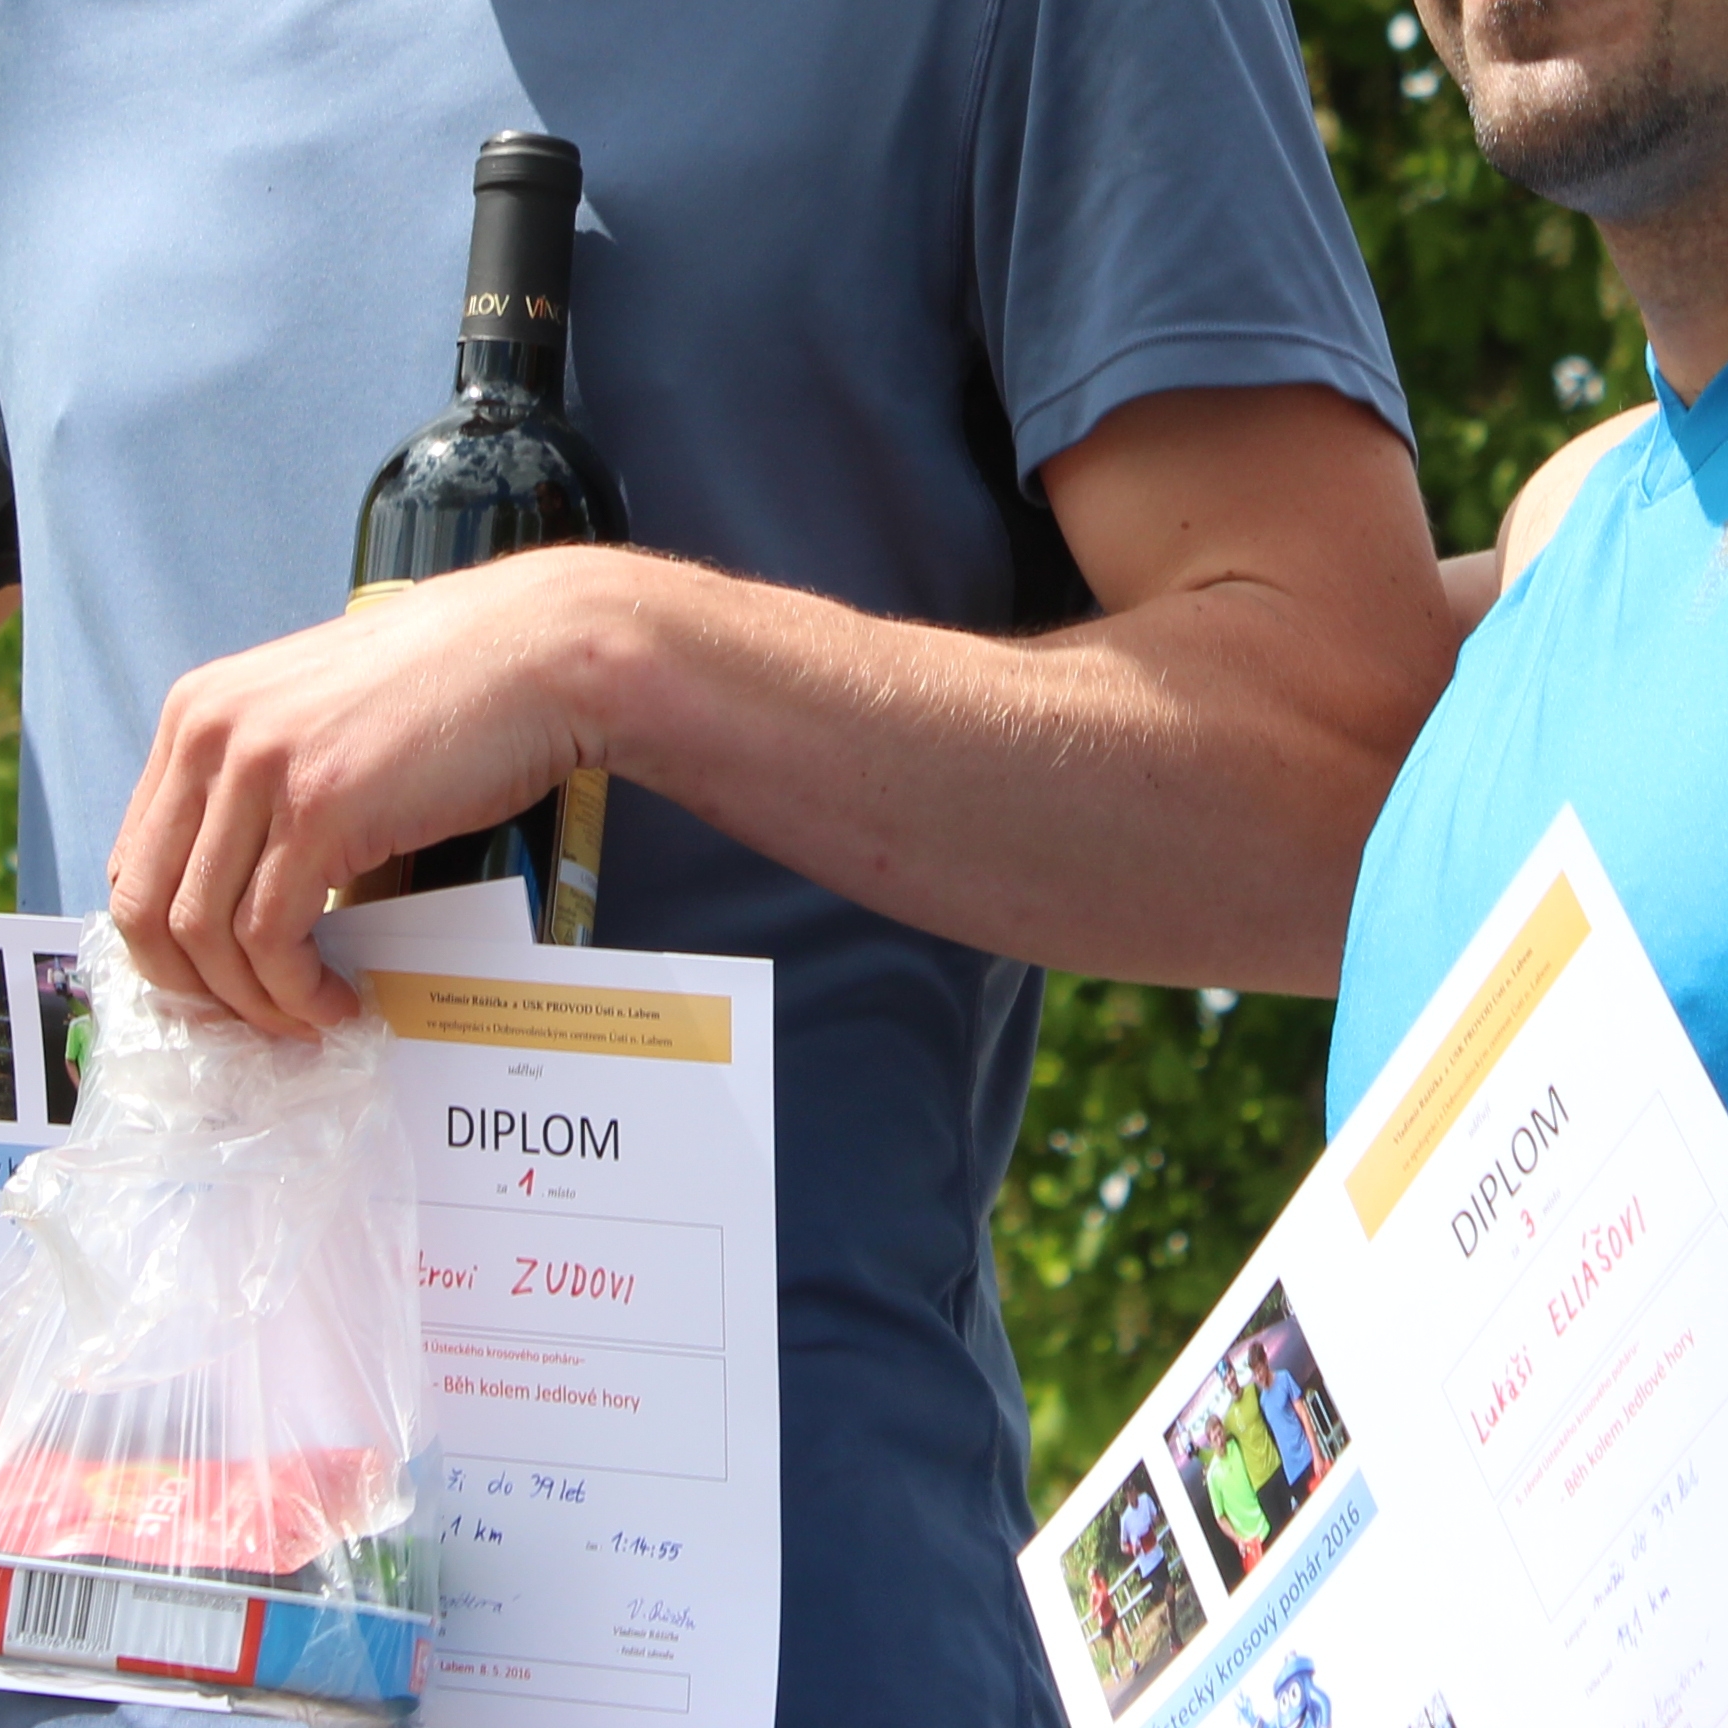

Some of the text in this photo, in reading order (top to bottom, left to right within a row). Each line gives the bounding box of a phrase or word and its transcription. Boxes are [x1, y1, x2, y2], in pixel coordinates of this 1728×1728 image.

[522, 999, 544, 1013] USK
[546, 1001, 593, 1016] PROVOD
[628, 1007, 661, 1021] Labem
[640, 1033, 673, 1048] Labem
[447, 1105, 621, 1162] DIPLOM
[518, 1167, 535, 1197] 1
[1450, 1083, 1571, 1260] DIPLOM
[1519, 1207, 1537, 1240] 3
[510, 1256, 635, 1306] ZUDOVI
[1469, 1192, 1647, 1447] Lukáši ELIÁŠOVI
[443, 1374, 641, 1415] Běh kolem Jedlové hory
[1563, 1326, 1696, 1499] Běh kolem Jedlové hory
[487, 1470, 514, 1497] do
[529, 1472, 555, 1502] 39
[474, 1518, 504, 1546] km
[611, 1530, 683, 1562] 1:14:55
[1152, 1499, 1362, 1728] tecký krosový pohár 2016
[504, 1667, 532, 1682] 2016
